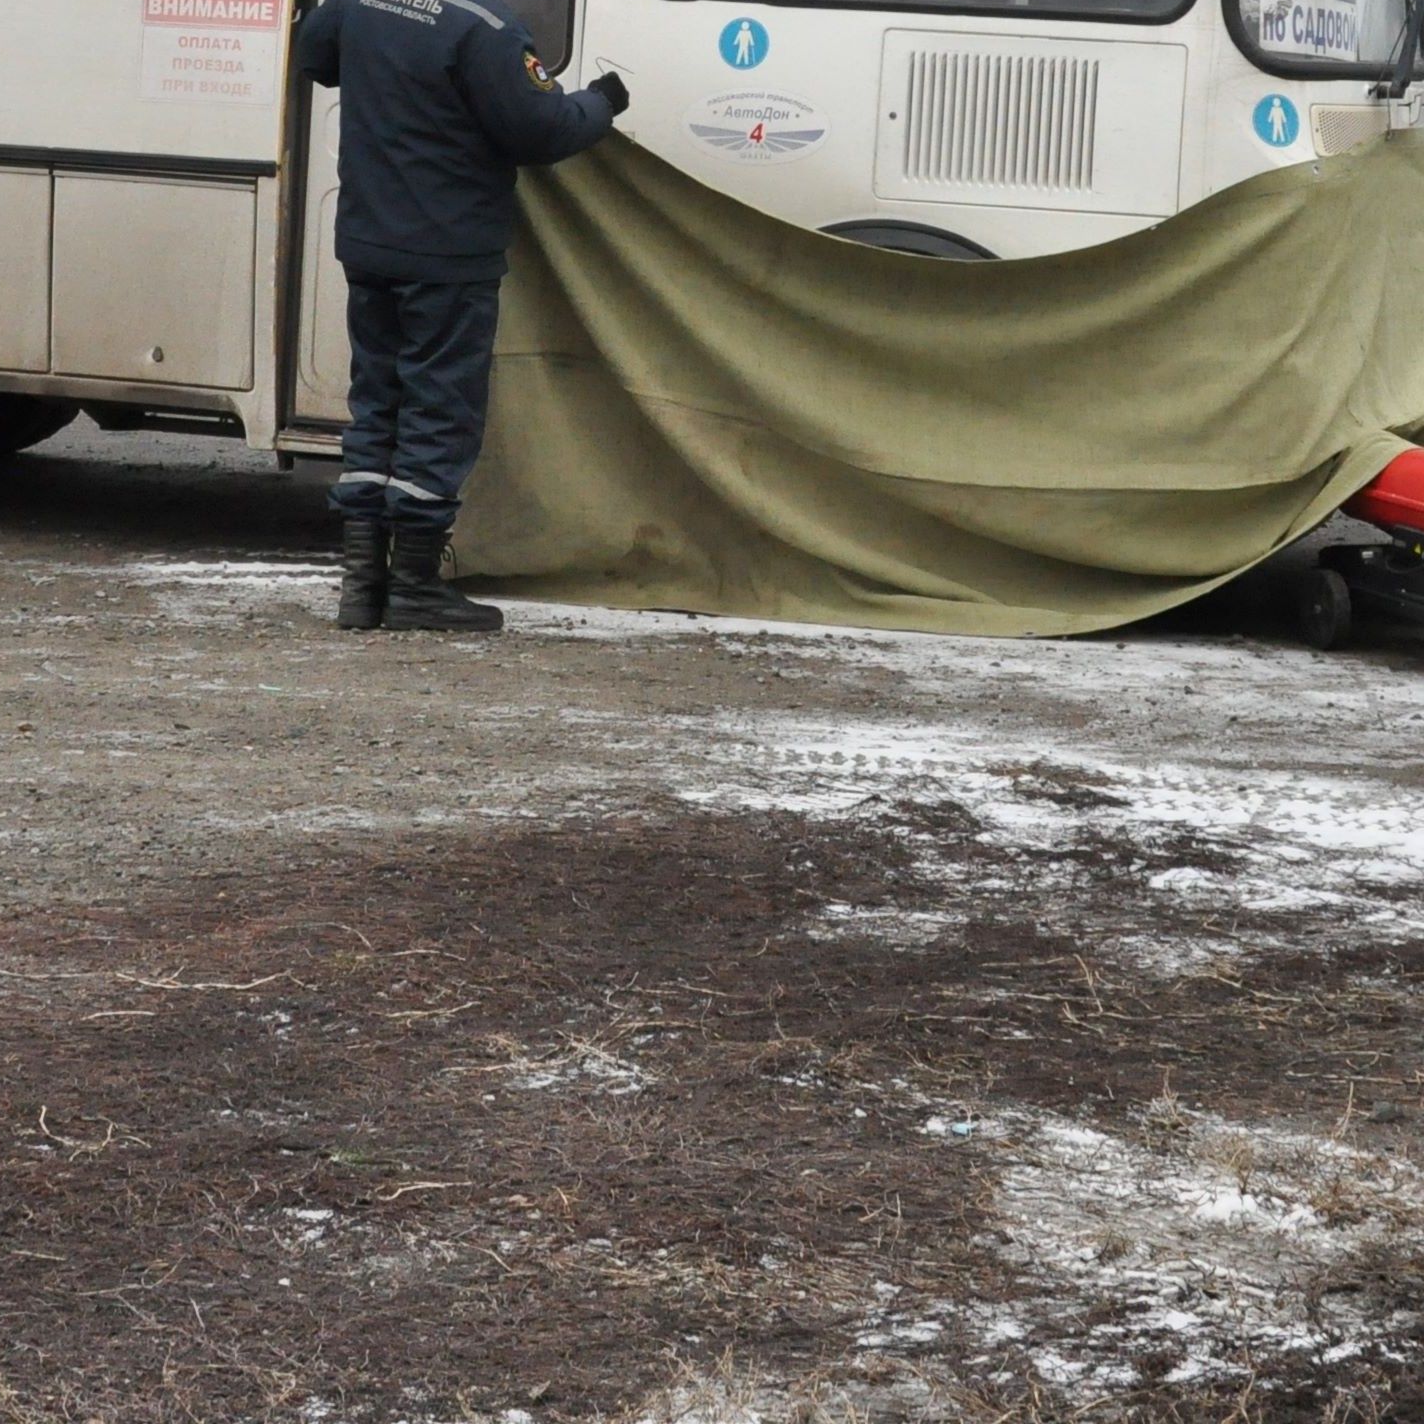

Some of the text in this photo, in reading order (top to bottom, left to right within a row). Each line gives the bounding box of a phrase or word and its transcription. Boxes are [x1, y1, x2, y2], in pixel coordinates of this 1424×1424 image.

[402, 9, 436, 25] ОБЛАСТЬ
[178, 36, 242, 51] ОПЛАТА
[172, 58, 244, 73] ПРОЕЗДА
[162, 79, 252, 96] ПРИ ВХОДЕ
[724, 106, 789, 122] АвтоДон
[749, 122, 763, 144] 4
